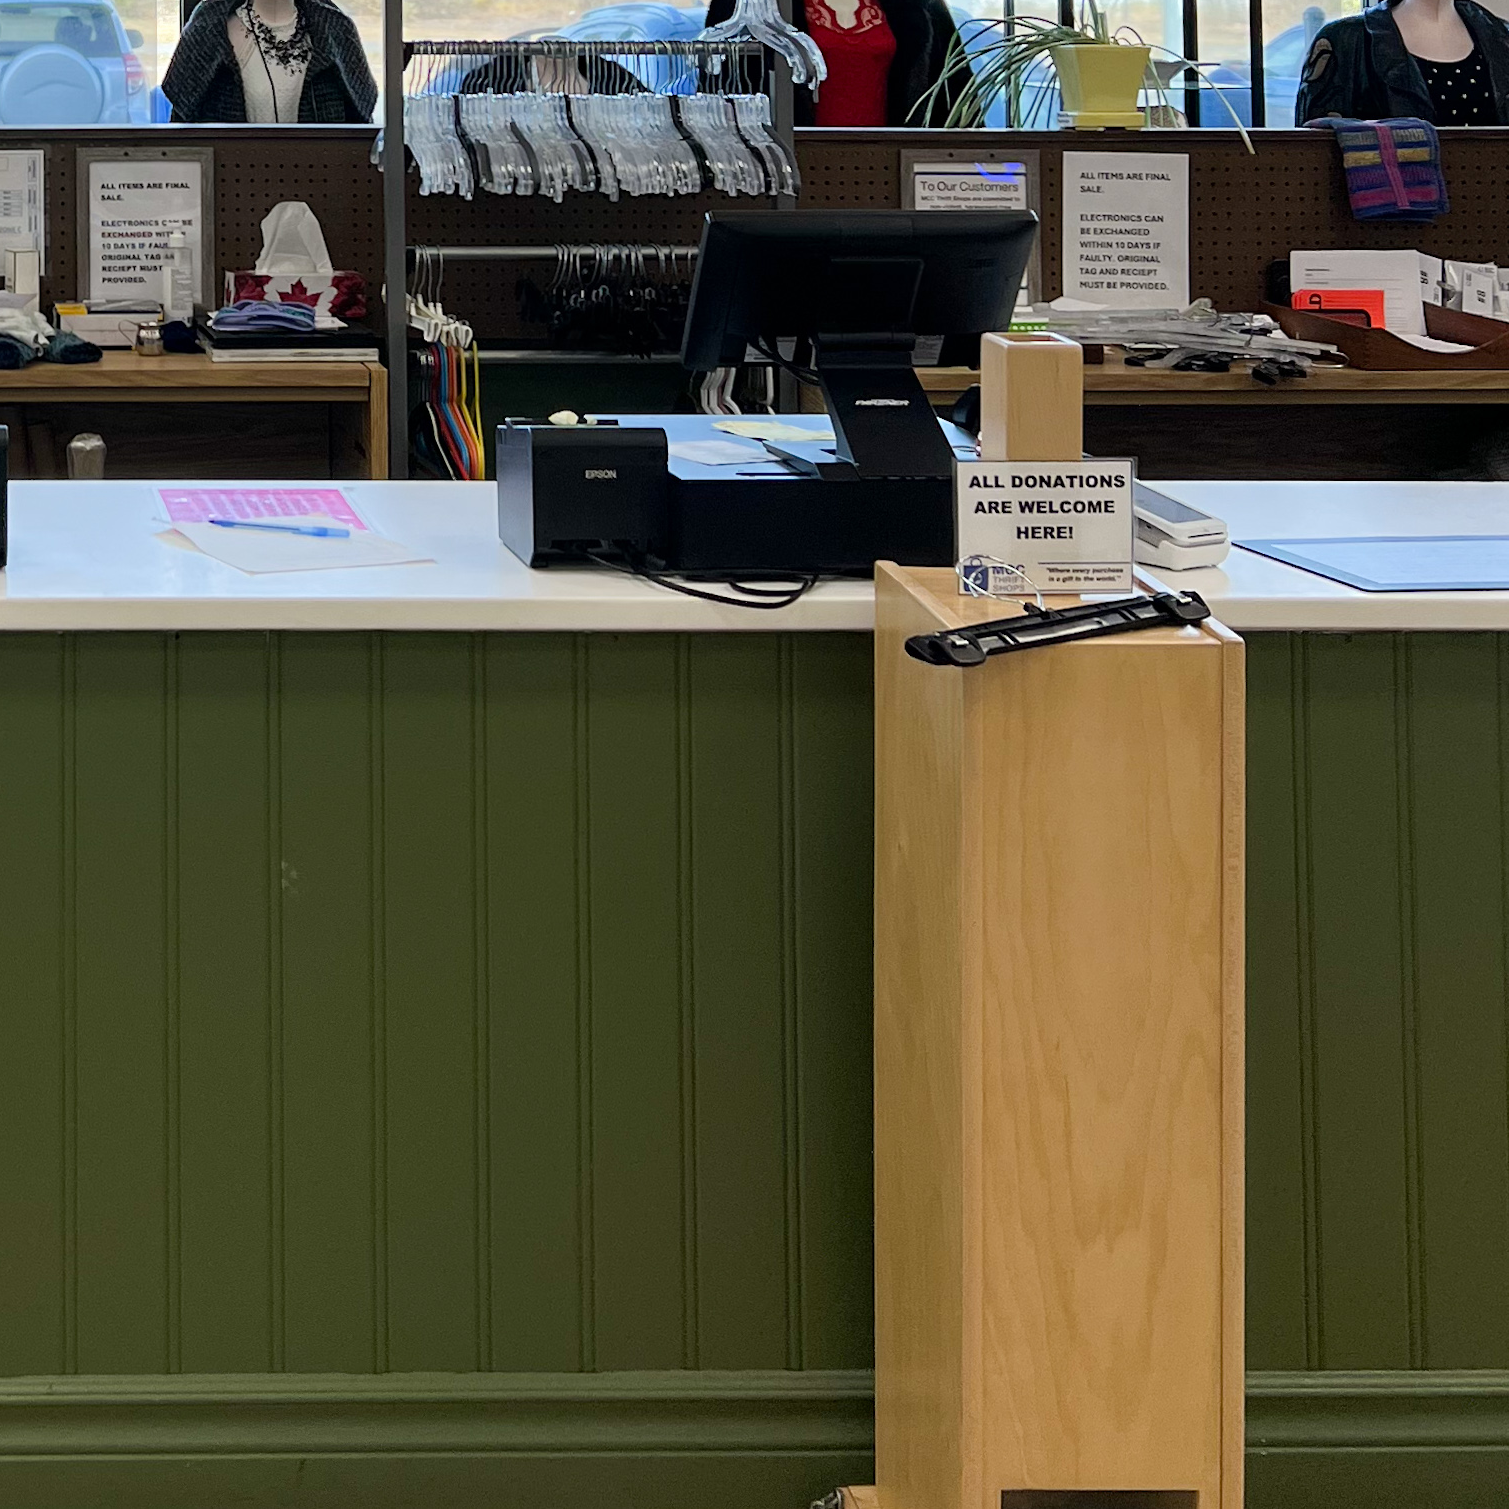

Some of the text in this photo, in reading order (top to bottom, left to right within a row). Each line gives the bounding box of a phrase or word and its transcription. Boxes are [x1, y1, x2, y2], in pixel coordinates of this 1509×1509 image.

[1080, 172, 1096, 180] ALL
[1097, 172, 1124, 180] ITEMS
[1146, 173, 1171, 181] FINAL
[920, 181, 1019, 192] To Our Customers
[101, 194, 124, 202] SALE.
[101, 219, 159, 227] ELECTRONICS
[1080, 214, 1164, 223] ELECTRONICS CAN
[101, 231, 153, 239] EXCHANGED
[1093, 228, 1150, 236] EXCHANGED
[1080, 241, 1113, 249] WITHIN
[1115, 241, 1125, 249] 10
[1080, 254, 1161, 263] FAULTY. ORIGINAL
[1099, 268, 1118, 276] AND
[1080, 281, 1169, 290] MUST BE PROVIDED.
[585, 469, 617, 479] EPSON
[969, 475, 1125, 488] ALL DONATIONS
[974, 500, 1115, 514] ARE WELCOME
[1016, 526, 1073, 539] HERE!
[992, 576, 1026, 584] THRIFT
[992, 584, 1026, 592] SHOPS
